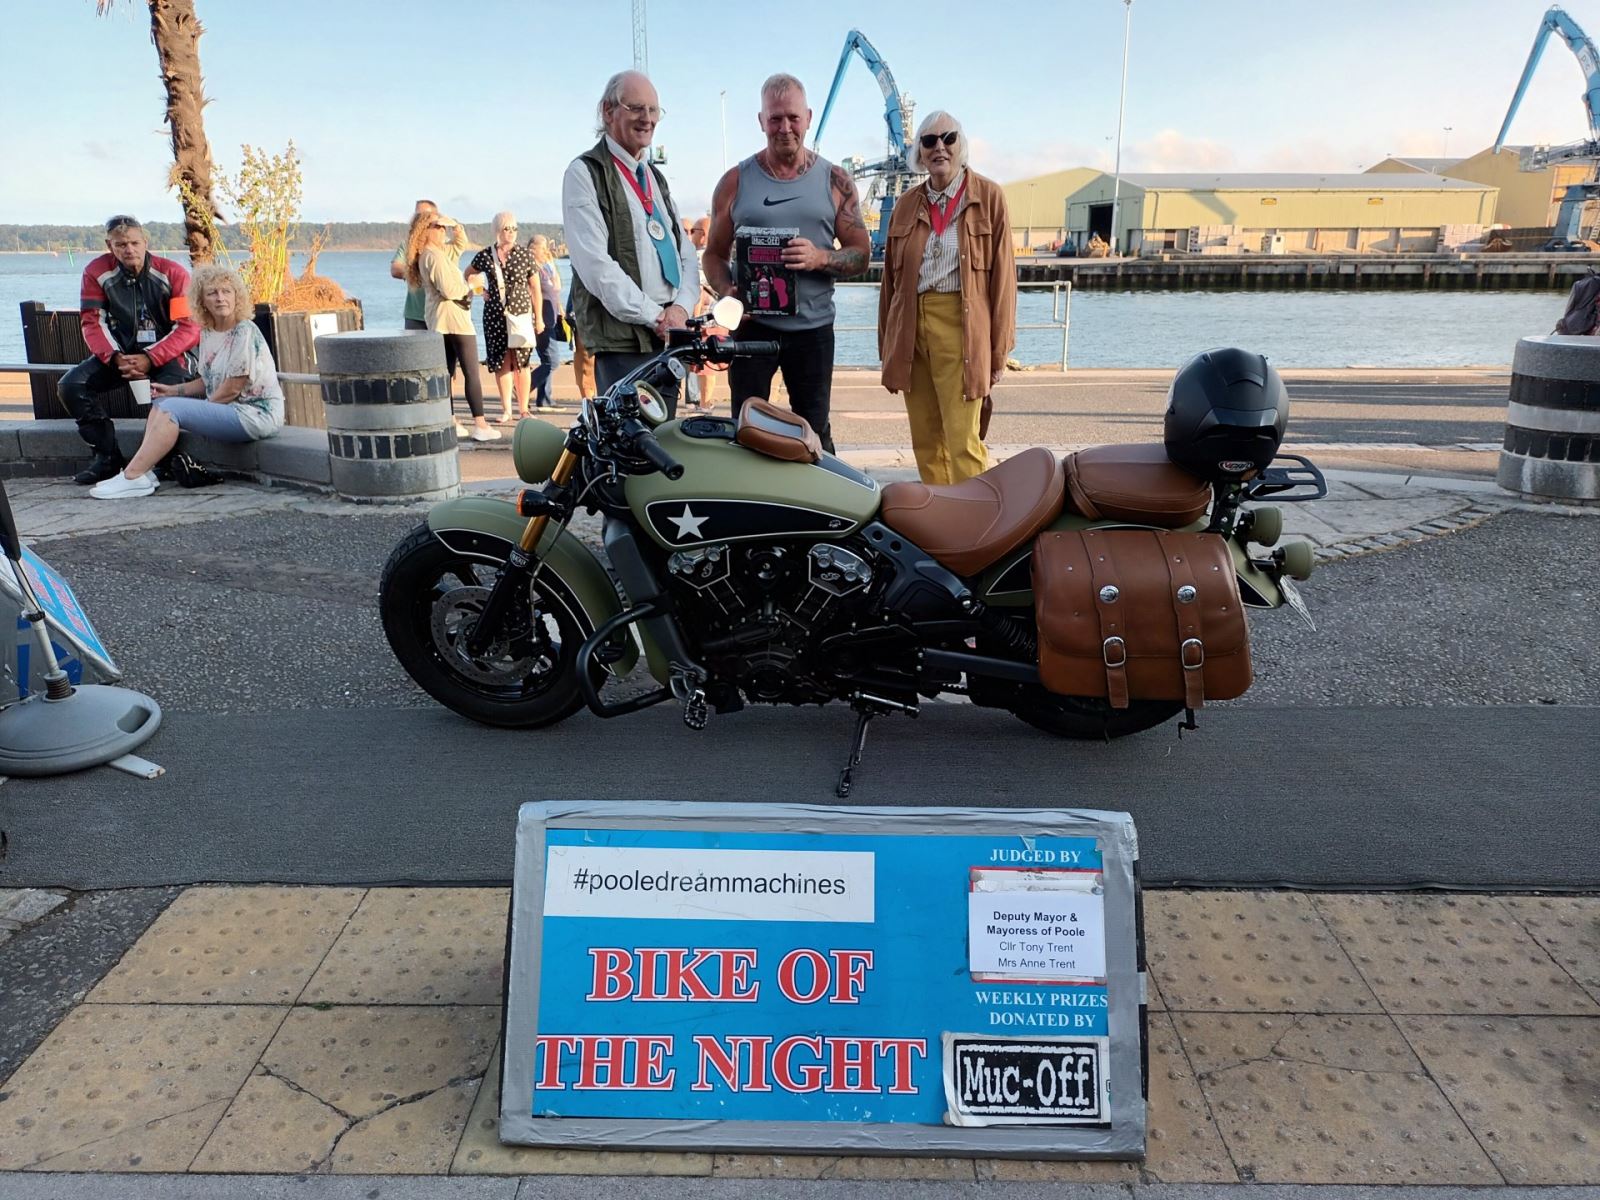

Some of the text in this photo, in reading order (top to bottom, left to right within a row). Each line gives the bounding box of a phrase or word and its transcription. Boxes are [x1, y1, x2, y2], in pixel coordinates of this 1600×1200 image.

[990, 849, 1082, 863] JUDGED BY
[573, 867, 846, 896] #pooledreammachines
[993, 911, 1078, 924] Deputy Mayor &
[986, 925, 1085, 937] Mayoress of Poole
[999, 941, 1073, 954] Cllr Tony Trent
[998, 958, 1075, 969] Mrs Anne Trent
[586, 947, 875, 1004] BIKE OF
[975, 991, 1108, 1007] WEEKLY PRIZES
[990, 1012, 1096, 1027] DONATED BY
[535, 1034, 928, 1095] THE NIGHT
[963, 1055, 1090, 1106] Muc-Off
